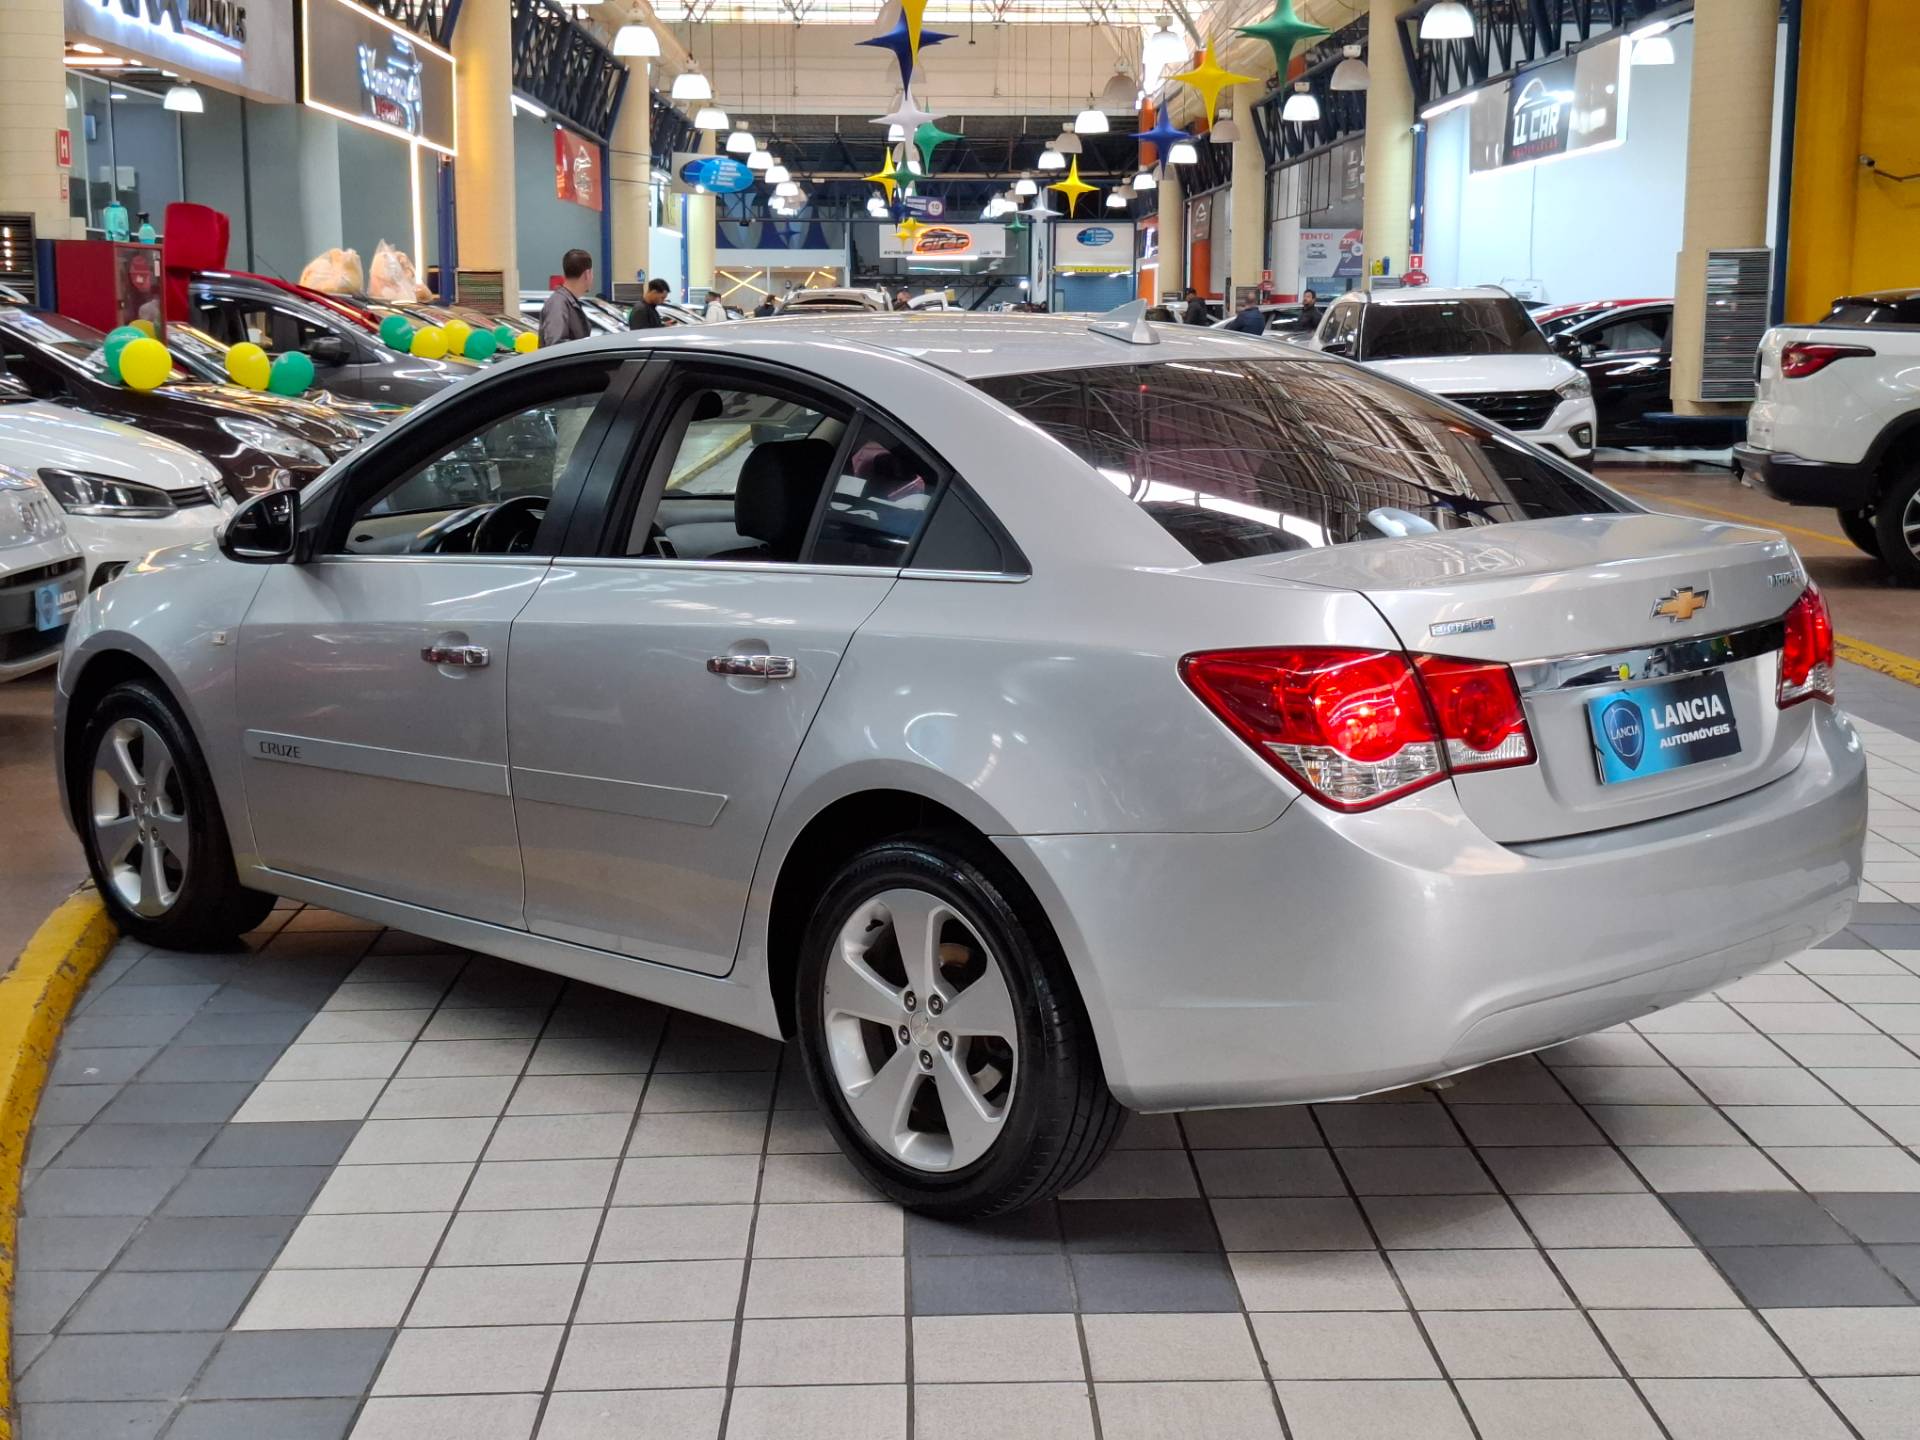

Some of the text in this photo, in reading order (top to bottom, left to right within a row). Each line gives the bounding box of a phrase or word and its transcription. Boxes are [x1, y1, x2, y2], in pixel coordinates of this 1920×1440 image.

[1529, 101, 1561, 142] CAR
[60, 135, 69, 158] H
[1651, 694, 1725, 730] LANCIA
[1610, 724, 1640, 740] LANCIA
[1659, 723, 1731, 749] AUTOMÓVEIS
[259, 741, 302, 759] CRUZE
